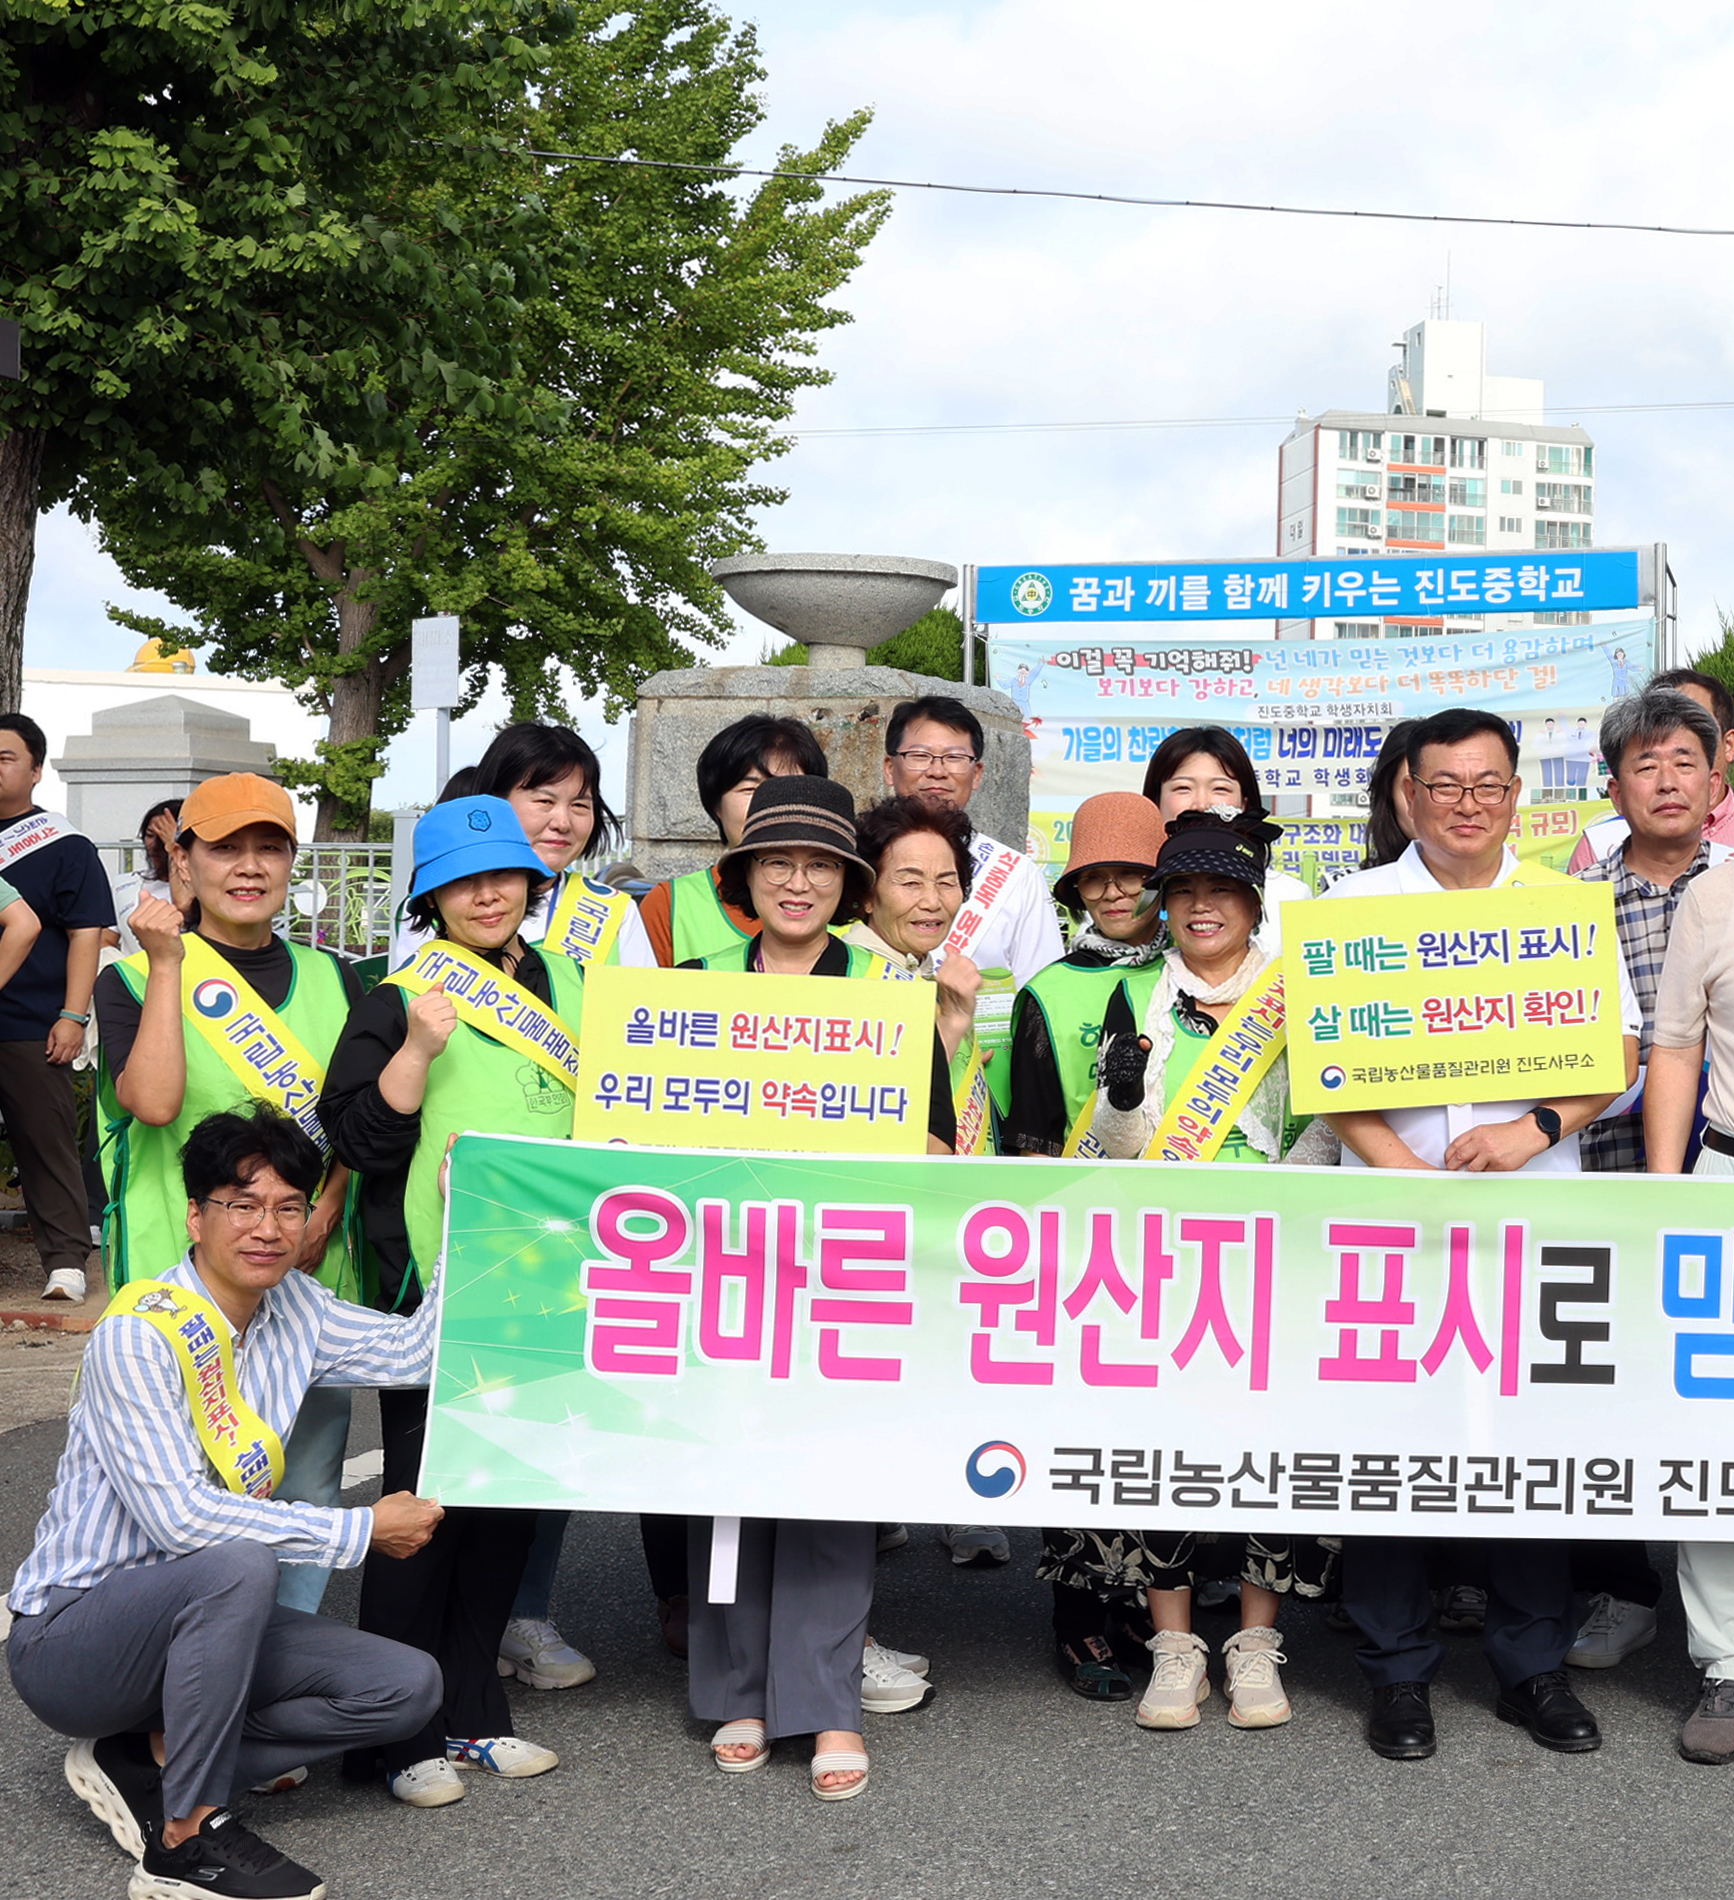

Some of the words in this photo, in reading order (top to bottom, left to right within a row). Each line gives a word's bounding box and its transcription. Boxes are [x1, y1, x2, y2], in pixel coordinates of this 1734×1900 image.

[1070, 576, 1135, 612] 꿈과
[1145, 575, 1212, 612] 끼를
[1223, 573, 1289, 610] 함께
[1302, 570, 1402, 608] 키우는
[1414, 565, 1585, 605] 진도중학교
[1056, 648, 1104, 675] 이걸
[1111, 648, 1135, 675] 꼭
[1143, 648, 1254, 675] 기억해줘!
[1264, 650, 1288, 672] 넌
[1294, 648, 1342, 670] 네가
[1350, 649, 1390, 672] 믿는
[1396, 641, 1463, 667] 것보다
[1471, 641, 1493, 661] 더
[1503, 634, 1596, 666] 용감하며
[1096, 677, 1181, 698] 보기보다
[1188, 677, 1260, 701] 강하고,
[1298, 675, 1390, 699] 생각보다
[1396, 672, 1422, 692] 더
[1427, 665, 1520, 695] 똑똑하단
[1526, 665, 1558, 691] 걸!
[1257, 703, 1322, 719] 진도중학교
[1326, 701, 1393, 718] 학생자치회
[1062, 726, 1122, 763] 가을의
[1278, 727, 1317, 760] 너의
[1322, 726, 1384, 760] 미래도
[1271, 823, 1342, 846] 구조화
[974, 852, 1021, 910] 식중독
[1302, 939, 1337, 976] 팔
[1344, 936, 1409, 972] 때는
[1416, 928, 1510, 968] 원산지
[1518, 924, 1597, 960] 표시!
[626, 1006, 719, 1048] 올바른
[730, 1012, 904, 1056] 원산지표시!
[1307, 1005, 1342, 1042] 살
[1350, 1002, 1414, 1038] 때는
[1422, 993, 1515, 1033] 원산지
[1523, 989, 1601, 1027] 확인!
[1352, 1058, 1511, 1084] 국립농산물품질관리원
[1517, 1053, 1596, 1074] 진도사무소
[595, 1072, 654, 1112] 우리
[663, 1076, 751, 1116] 모두의
[761, 1080, 909, 1122] 약속입니다
[584, 1189, 915, 1383] 올바른
[957, 1204, 1274, 1393] 원산지
[1316, 1223, 1617, 1398] 표시로
[1049, 1446, 1635, 1518] 국립농산물품질관리원
